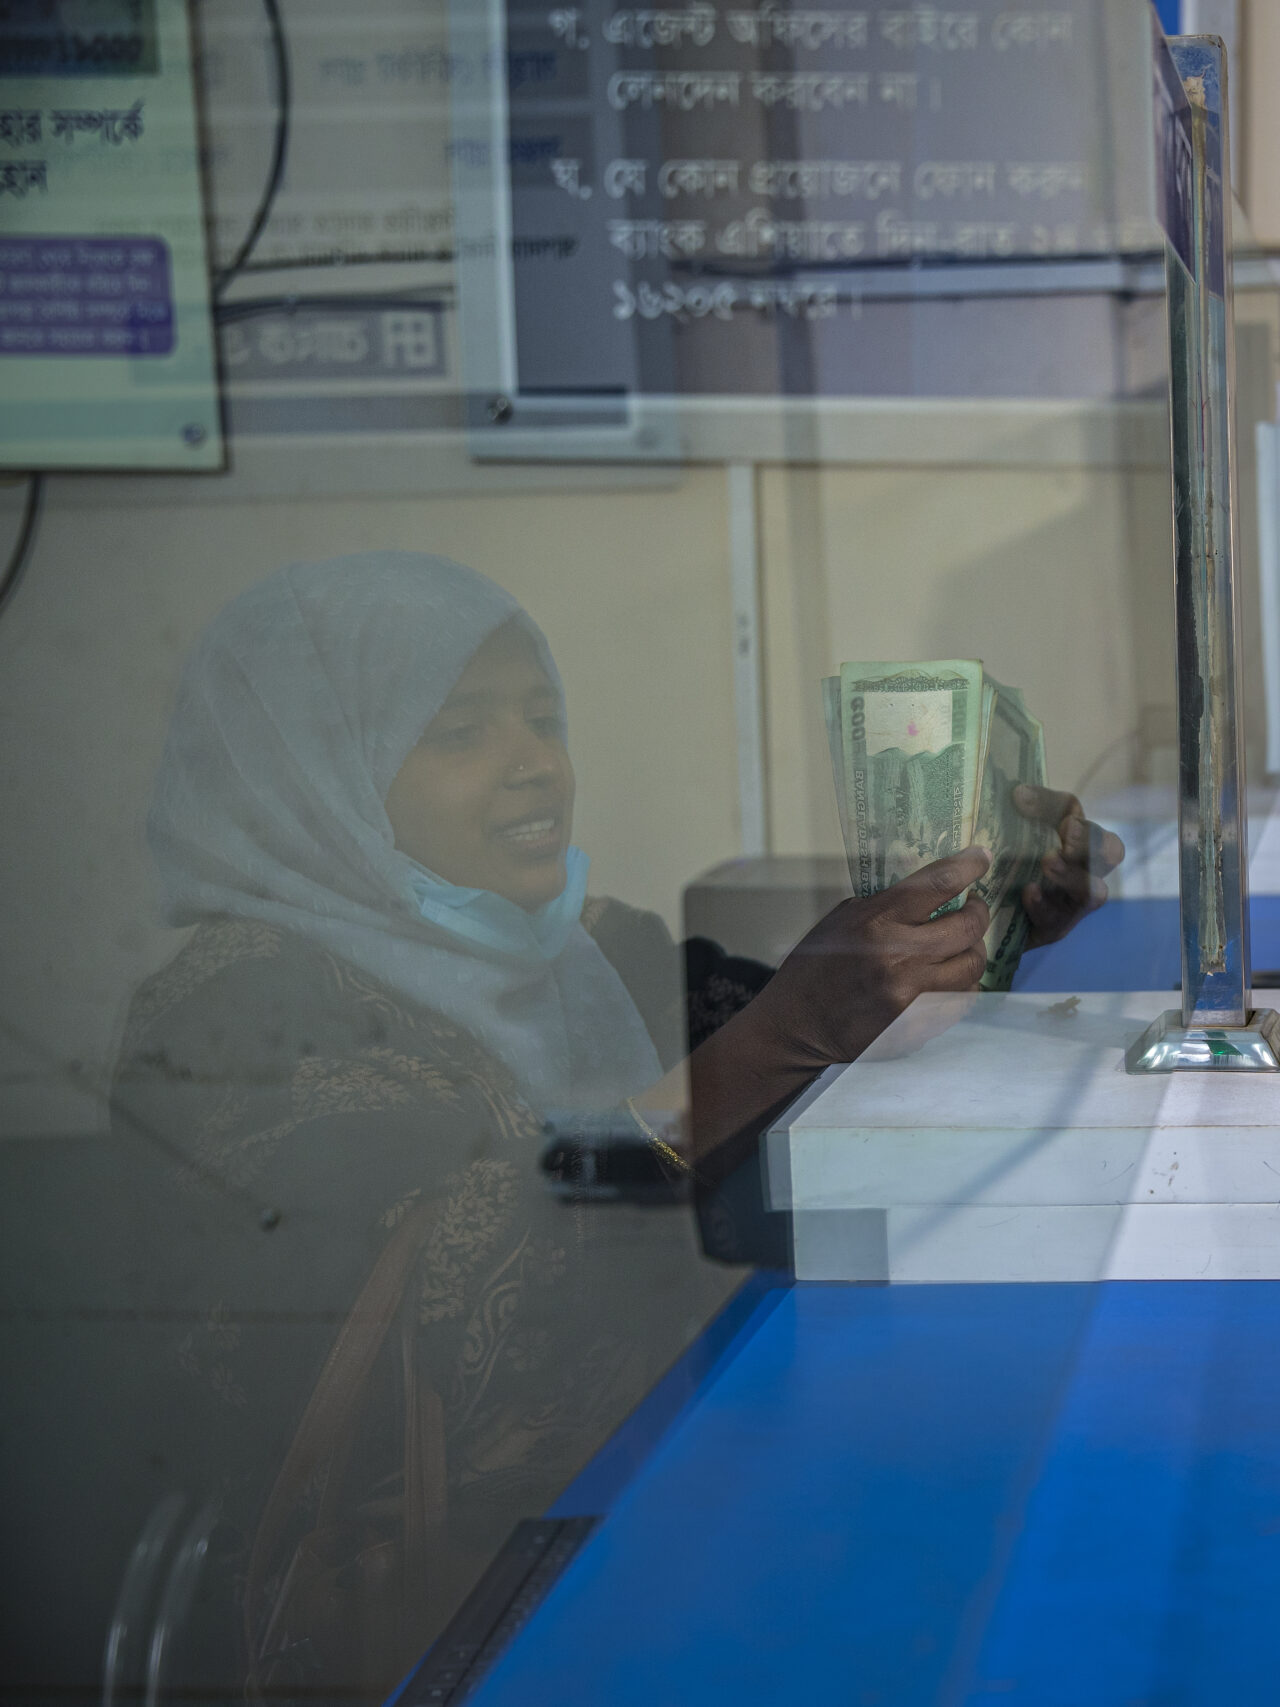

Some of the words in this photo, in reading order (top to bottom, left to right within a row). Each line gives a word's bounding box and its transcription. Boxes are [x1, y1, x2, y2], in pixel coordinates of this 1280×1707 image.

[727, 0, 867, 49] অফিসের
[879, 3, 978, 49] বাইরে
[991, 10, 1073, 50] কোন
[608, 70, 740, 110] লেনদেন
[750, 70, 868, 112] করবেন
[604, 159, 646, 199] যে
[657, 159, 739, 199] কোন
[914, 160, 994, 200] ফোন
[606, 219, 706, 260] ব্যাংক
[612, 279, 736, 322] ১৬২০৫
